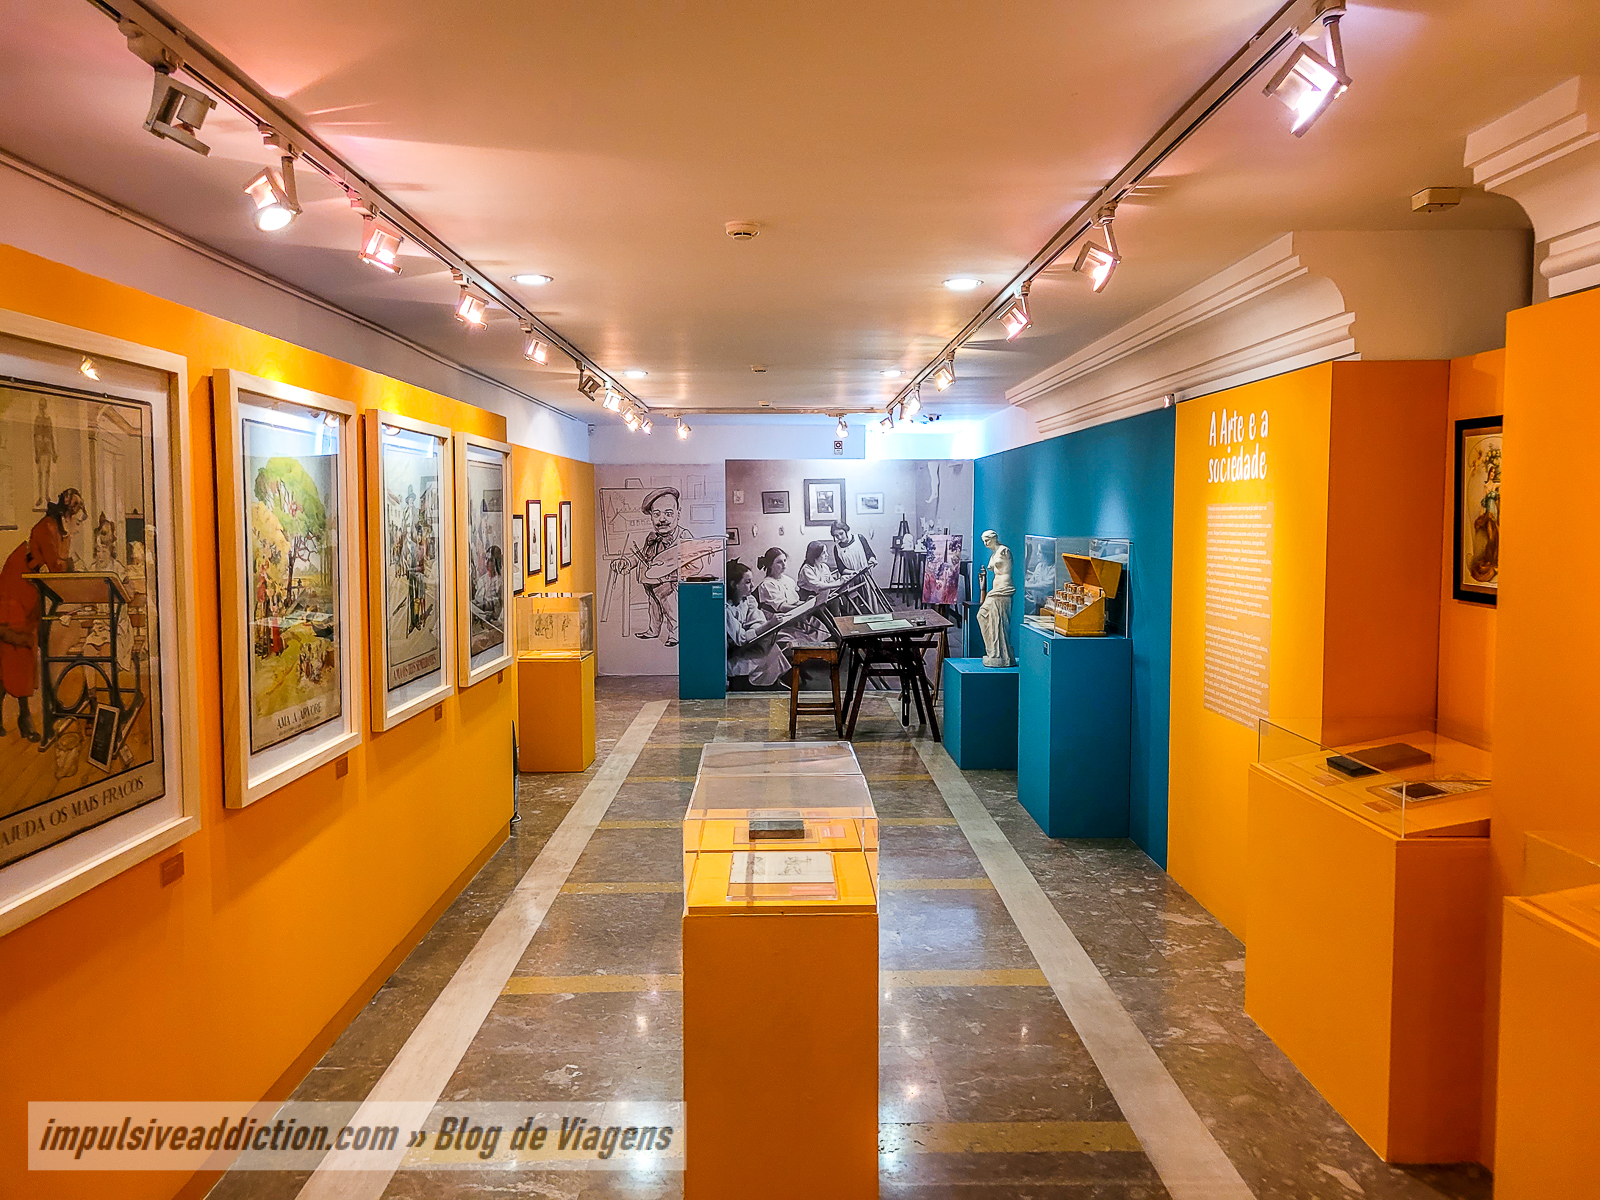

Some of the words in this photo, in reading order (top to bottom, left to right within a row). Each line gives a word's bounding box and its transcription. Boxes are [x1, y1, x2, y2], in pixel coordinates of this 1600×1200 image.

[1209, 411, 1217, 447] A
[1220, 408, 1245, 445] Arte
[1249, 412, 1257, 441] e
[1260, 410, 1269, 438] a
[1208, 443, 1268, 483] sociedade
[0, 817, 46, 848] AJUDA
[49, 806, 68, 827] OS
[71, 794, 99, 819] MAIS
[102, 775, 144, 806] FRACOS
